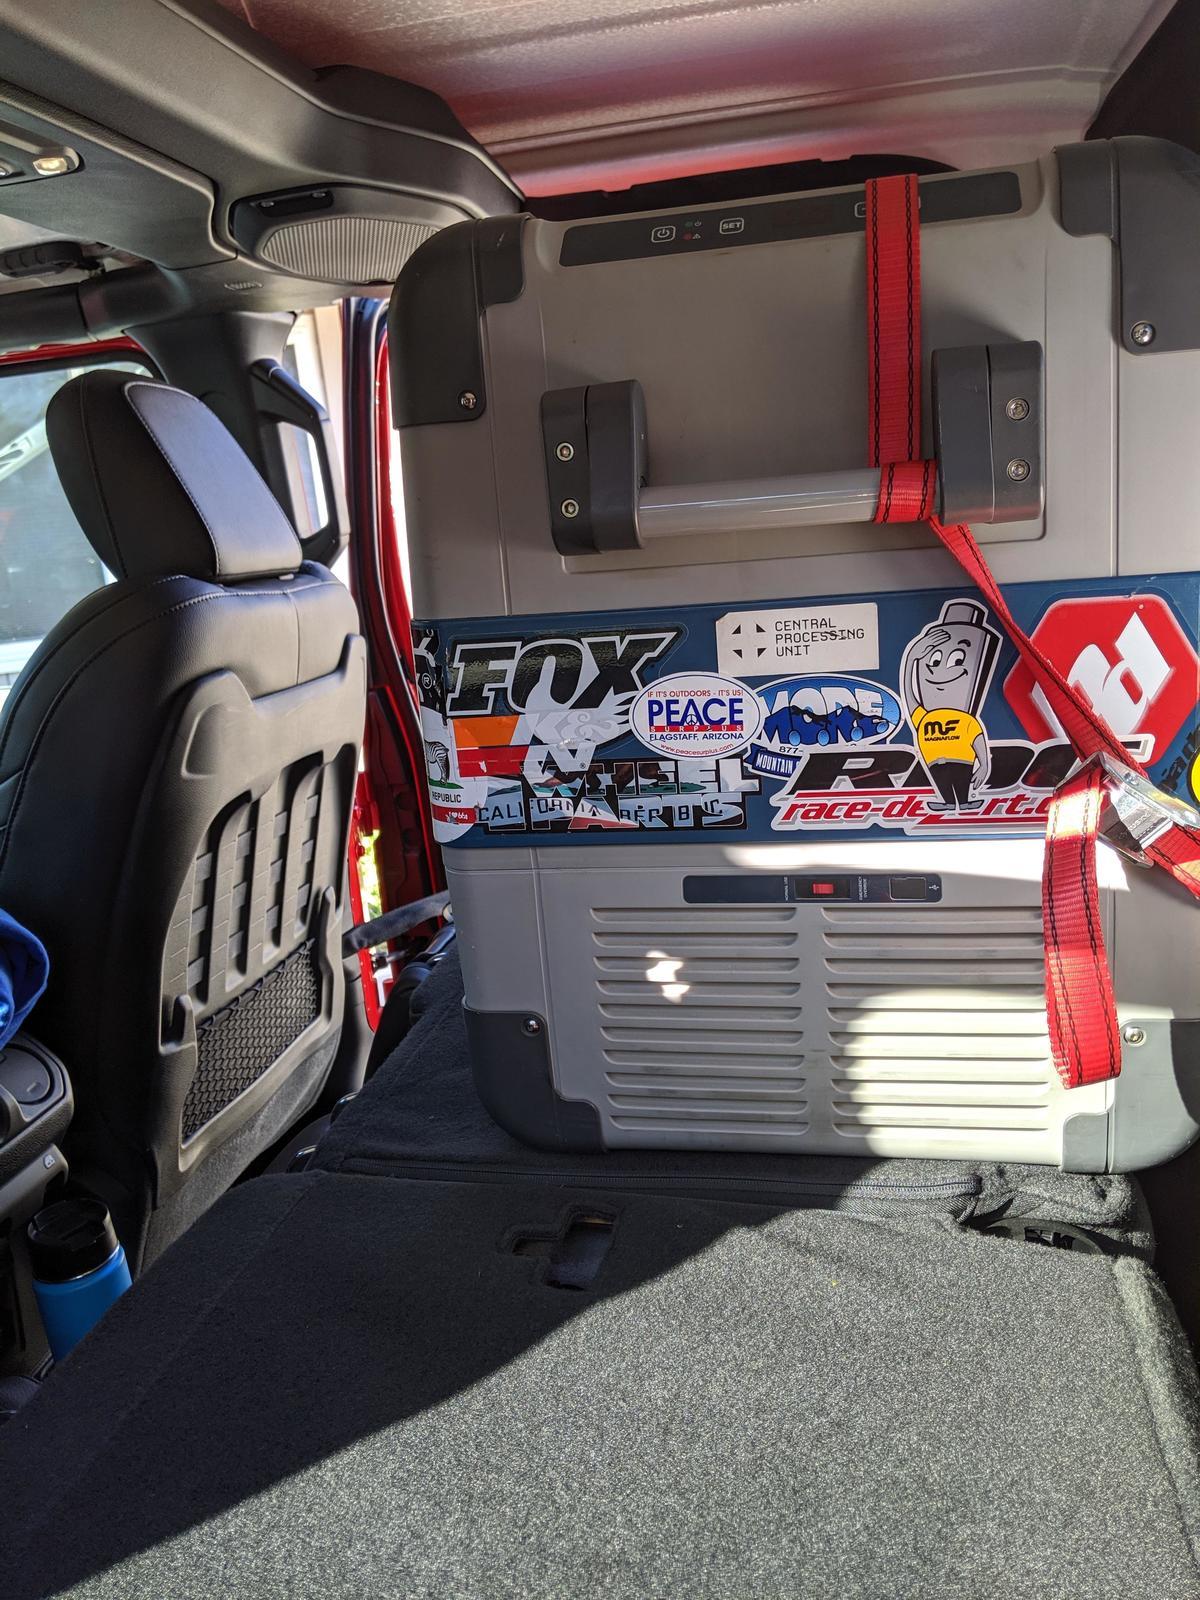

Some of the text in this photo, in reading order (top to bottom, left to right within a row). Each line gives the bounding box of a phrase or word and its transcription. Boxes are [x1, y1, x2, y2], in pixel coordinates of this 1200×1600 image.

[722, 222, 741, 230] SET
[775, 617, 837, 632] CENTRAL
[775, 628, 865, 645] PROCESSING
[776, 644, 811, 657] UNIT
[447, 631, 678, 716] FOX
[669, 690, 711, 698] OUTDOORS
[718, 689, 730, 697] IT'S
[647, 698, 744, 726] PEACE
[650, 725, 742, 733] SURPLUS
[649, 732, 744, 742] FLAGSTAFF, ARIZONA
[660, 742, 734, 756] www.peacesurplus.com
[755, 752, 793, 775] MOUNTAIN
[521, 759, 759, 798] WHEEL
[431, 790, 462, 804] REPUBLIC
[478, 798, 602, 823] CALIORNIA
[531, 793, 746, 832] PARTS
